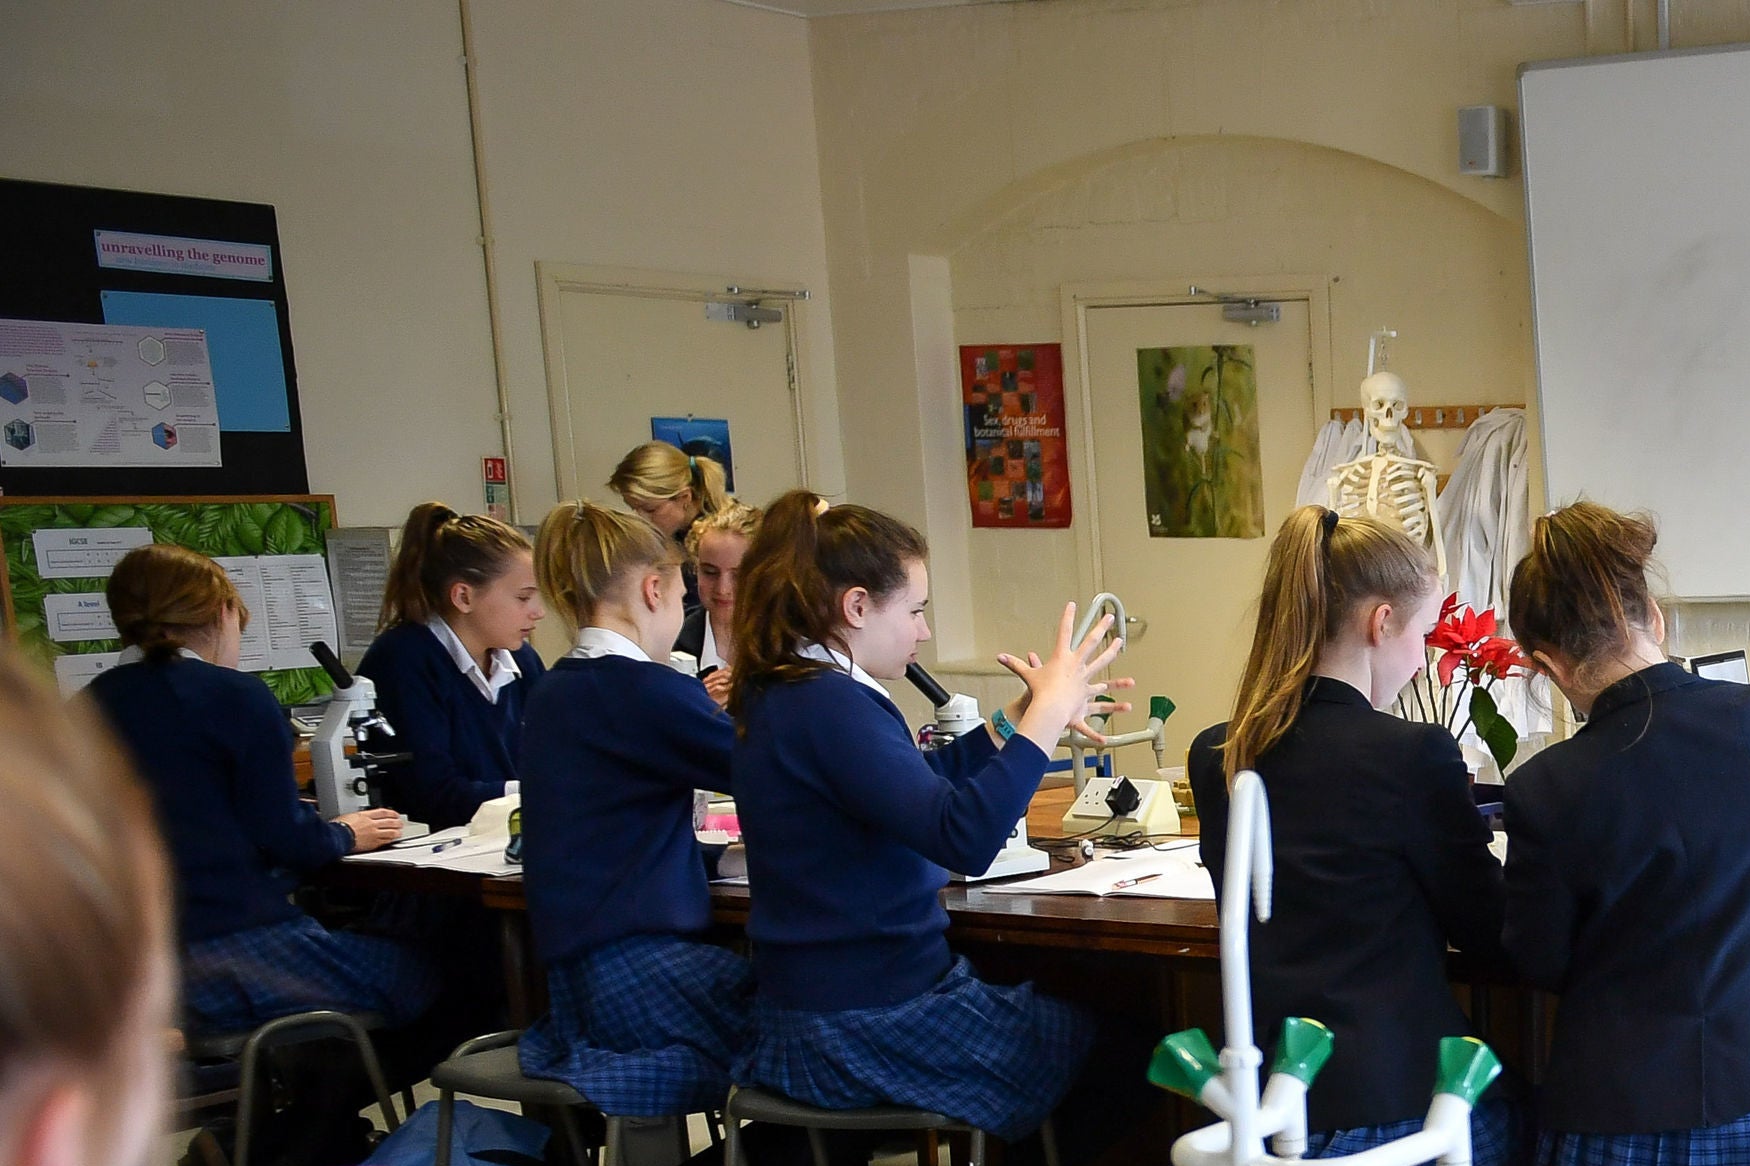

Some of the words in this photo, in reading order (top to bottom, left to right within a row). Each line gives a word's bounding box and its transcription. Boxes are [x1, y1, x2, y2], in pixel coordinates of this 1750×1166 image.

[101, 241, 184, 262] unravelling
[188, 247, 209, 262] the
[212, 252, 266, 267] genome
[1001, 414, 1028, 427] drugs
[1029, 414, 1047, 425] and
[973, 426, 1012, 438] botanical
